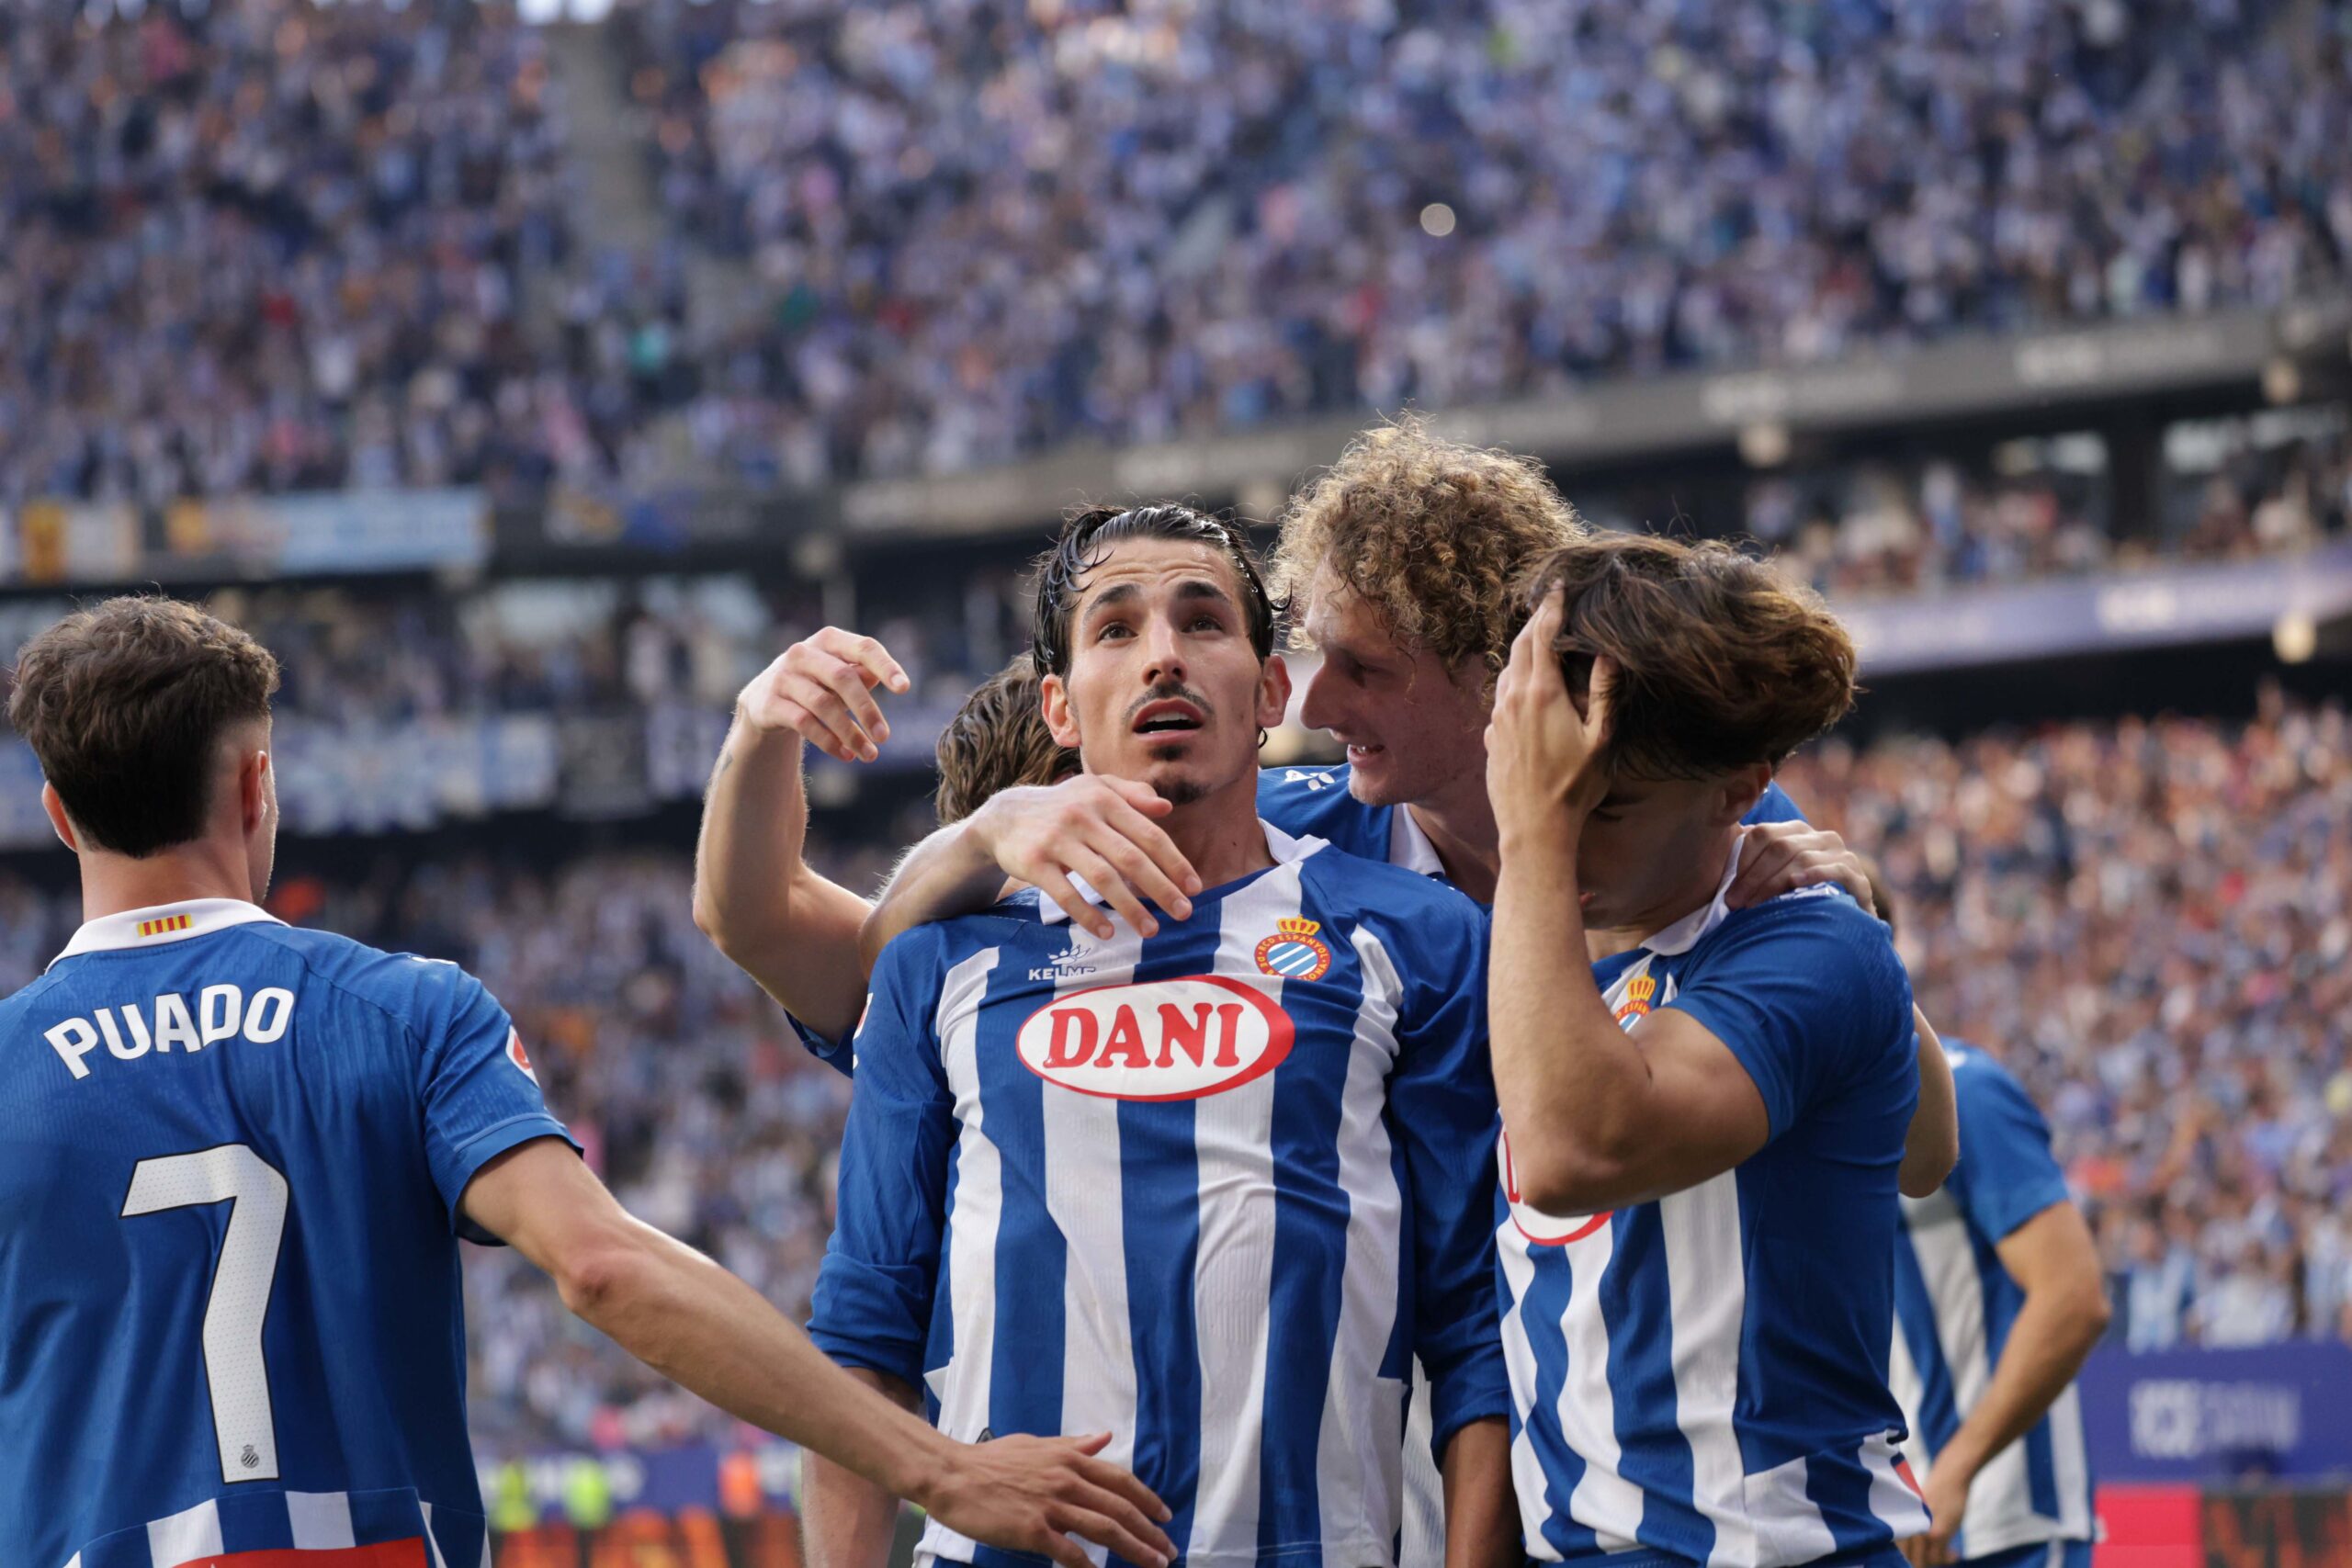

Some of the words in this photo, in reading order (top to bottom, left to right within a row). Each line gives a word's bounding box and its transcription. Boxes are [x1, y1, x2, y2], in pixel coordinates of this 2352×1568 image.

[1257, 937, 1276, 951] RCD
[1278, 934, 1329, 959] ESPANYOL
[1257, 956, 1269, 968] DE
[43, 983, 295, 1080] PUADO
[1042, 1002, 1244, 1069] DANI
[119, 1143, 289, 1485] 7
